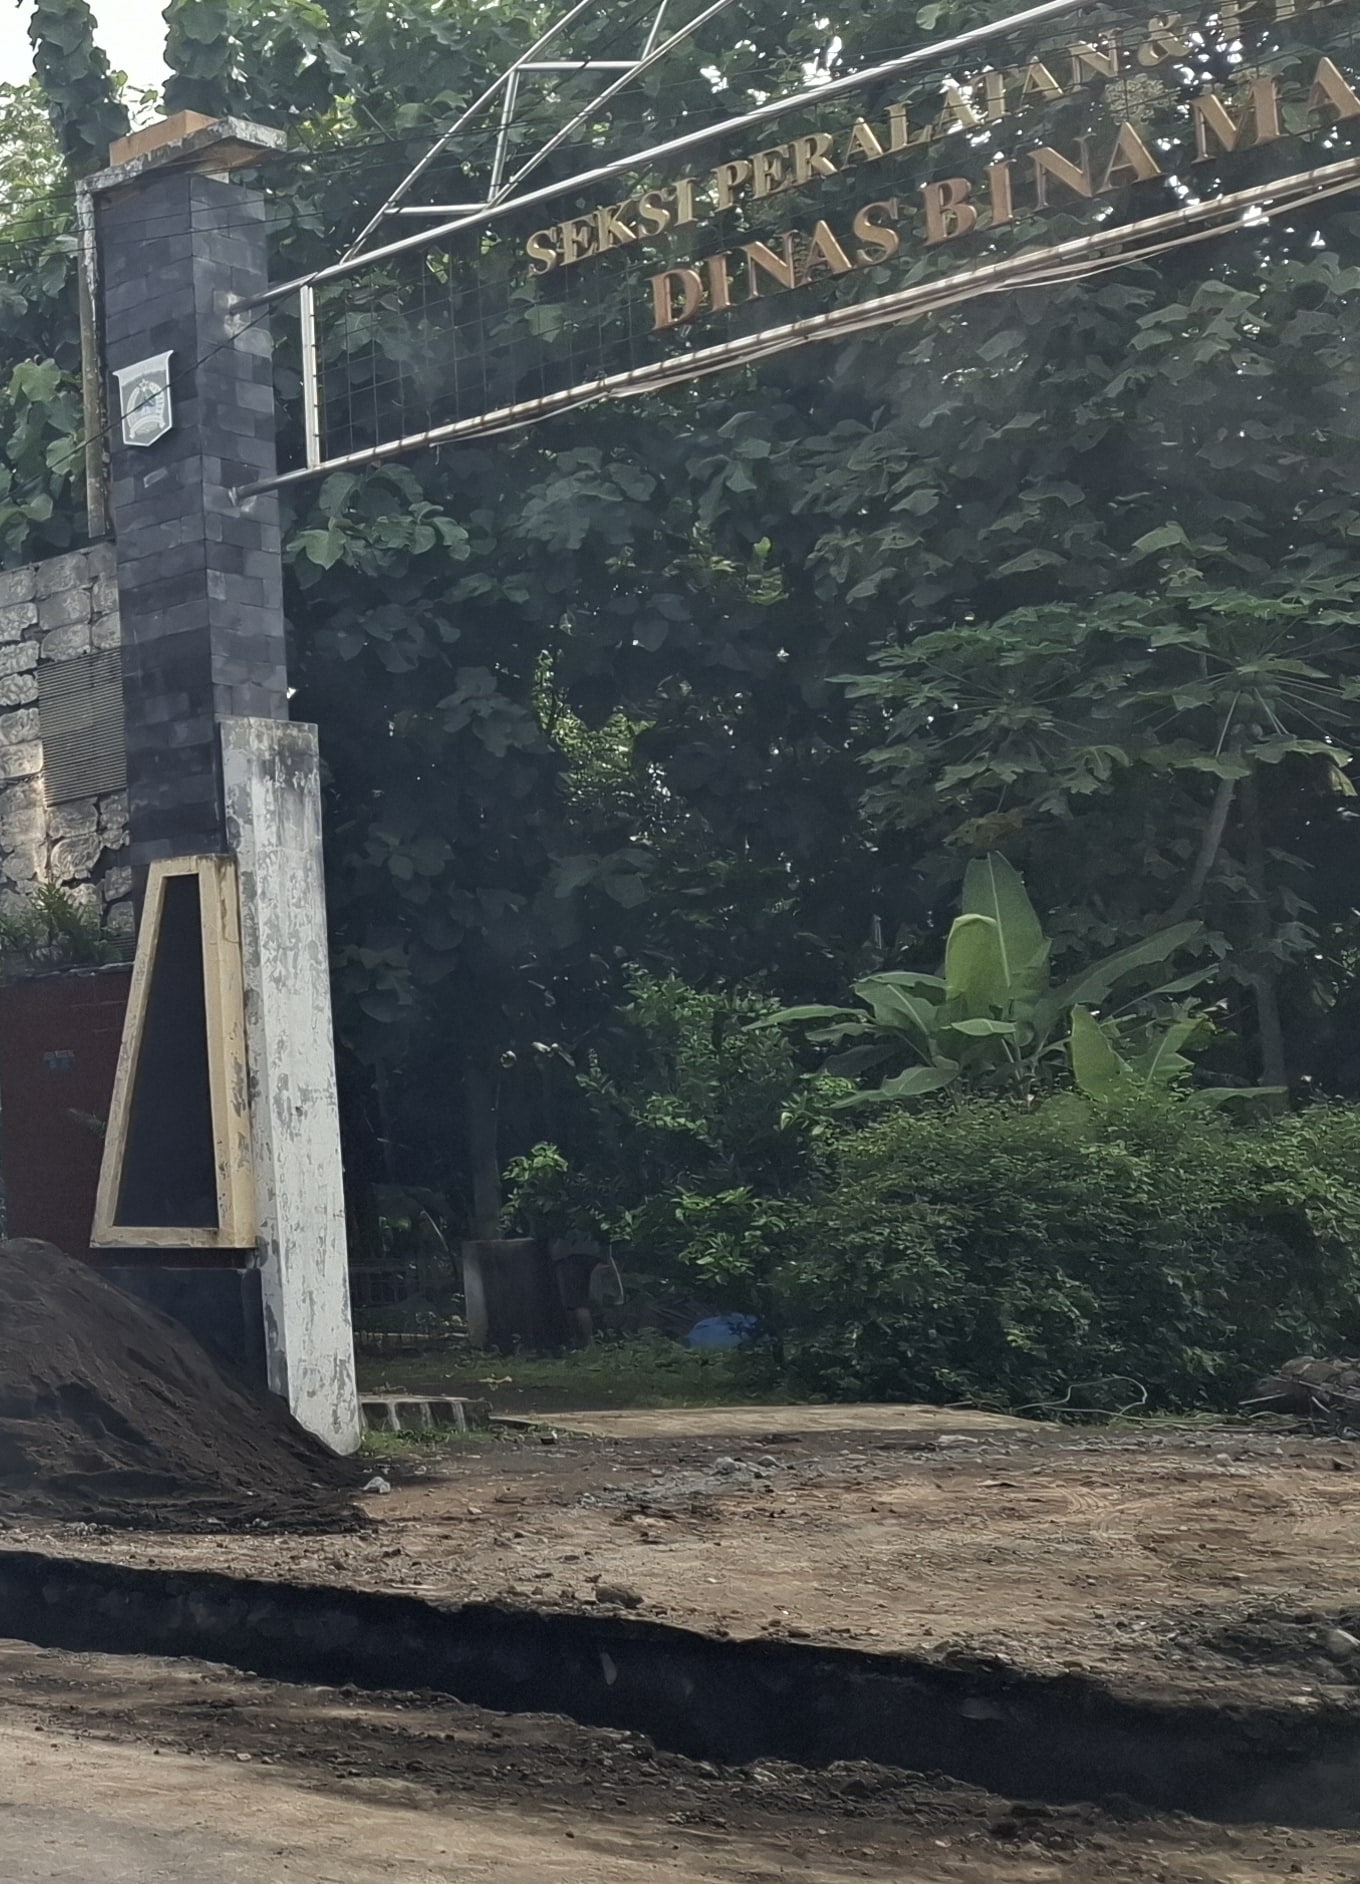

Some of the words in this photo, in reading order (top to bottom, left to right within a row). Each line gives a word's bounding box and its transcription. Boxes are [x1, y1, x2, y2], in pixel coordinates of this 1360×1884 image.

[526, 177, 698, 276] SEKSI
[712, 28, 1123, 213] PERALATAN
[1138, 11, 1192, 67] &
[647, 198, 899, 331] DINAS
[920, 122, 1164, 247] BINA
[1191, 56, 1360, 163] MA
